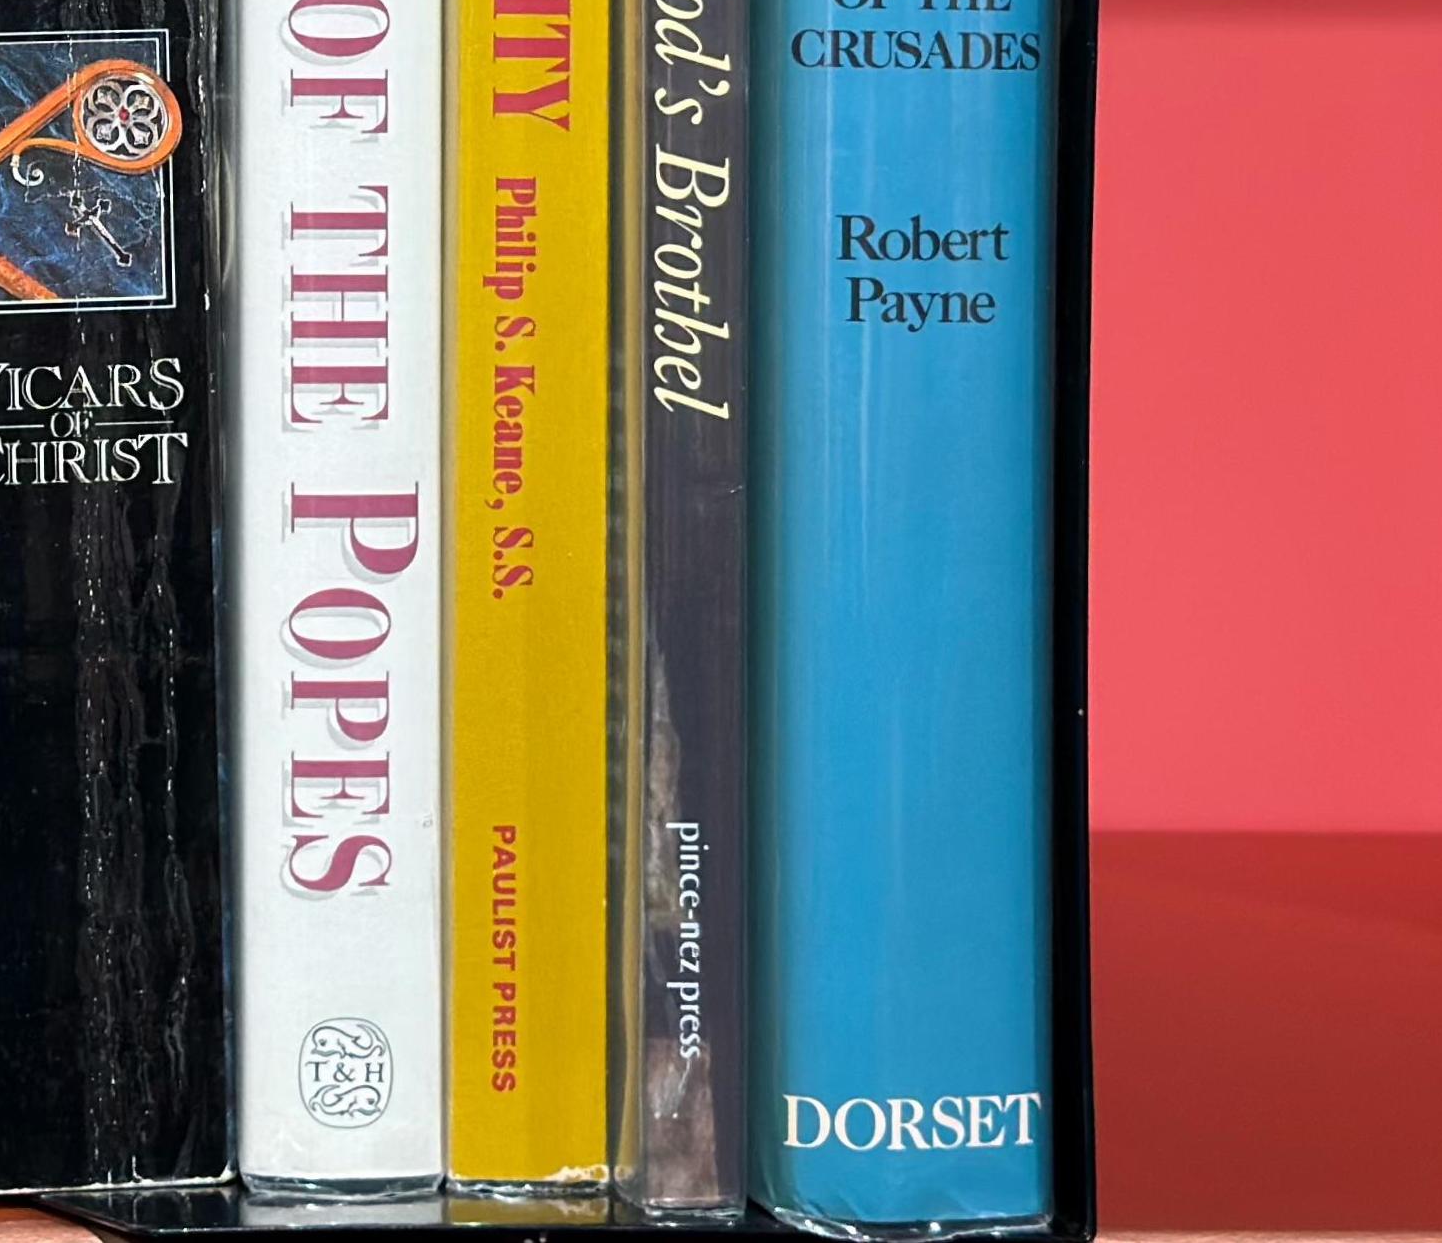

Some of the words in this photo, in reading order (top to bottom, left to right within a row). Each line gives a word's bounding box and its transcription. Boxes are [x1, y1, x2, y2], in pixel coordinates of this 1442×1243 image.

[792, 29, 1041, 70] CRUSADES
[482, 177, 537, 303] Philip
[653, 143, 730, 420] Brothel
[836, 214, 1009, 262] Robert
[289, 185, 388, 424] THE
[493, 315, 537, 352] S.
[845, 277, 996, 333] Payne
[49, 409, 90, 439] OF
[484, 364, 536, 509] Keane,
[491, 526, 534, 600] S.S.
[288, 481, 418, 893] POPES
[492, 824, 517, 972] PAULIST
[665, 820, 709, 974] pince-nez
[492, 982, 516, 1092] PRESS
[667, 980, 700, 1059] press
[782, 1091, 1042, 1151] DORSET
